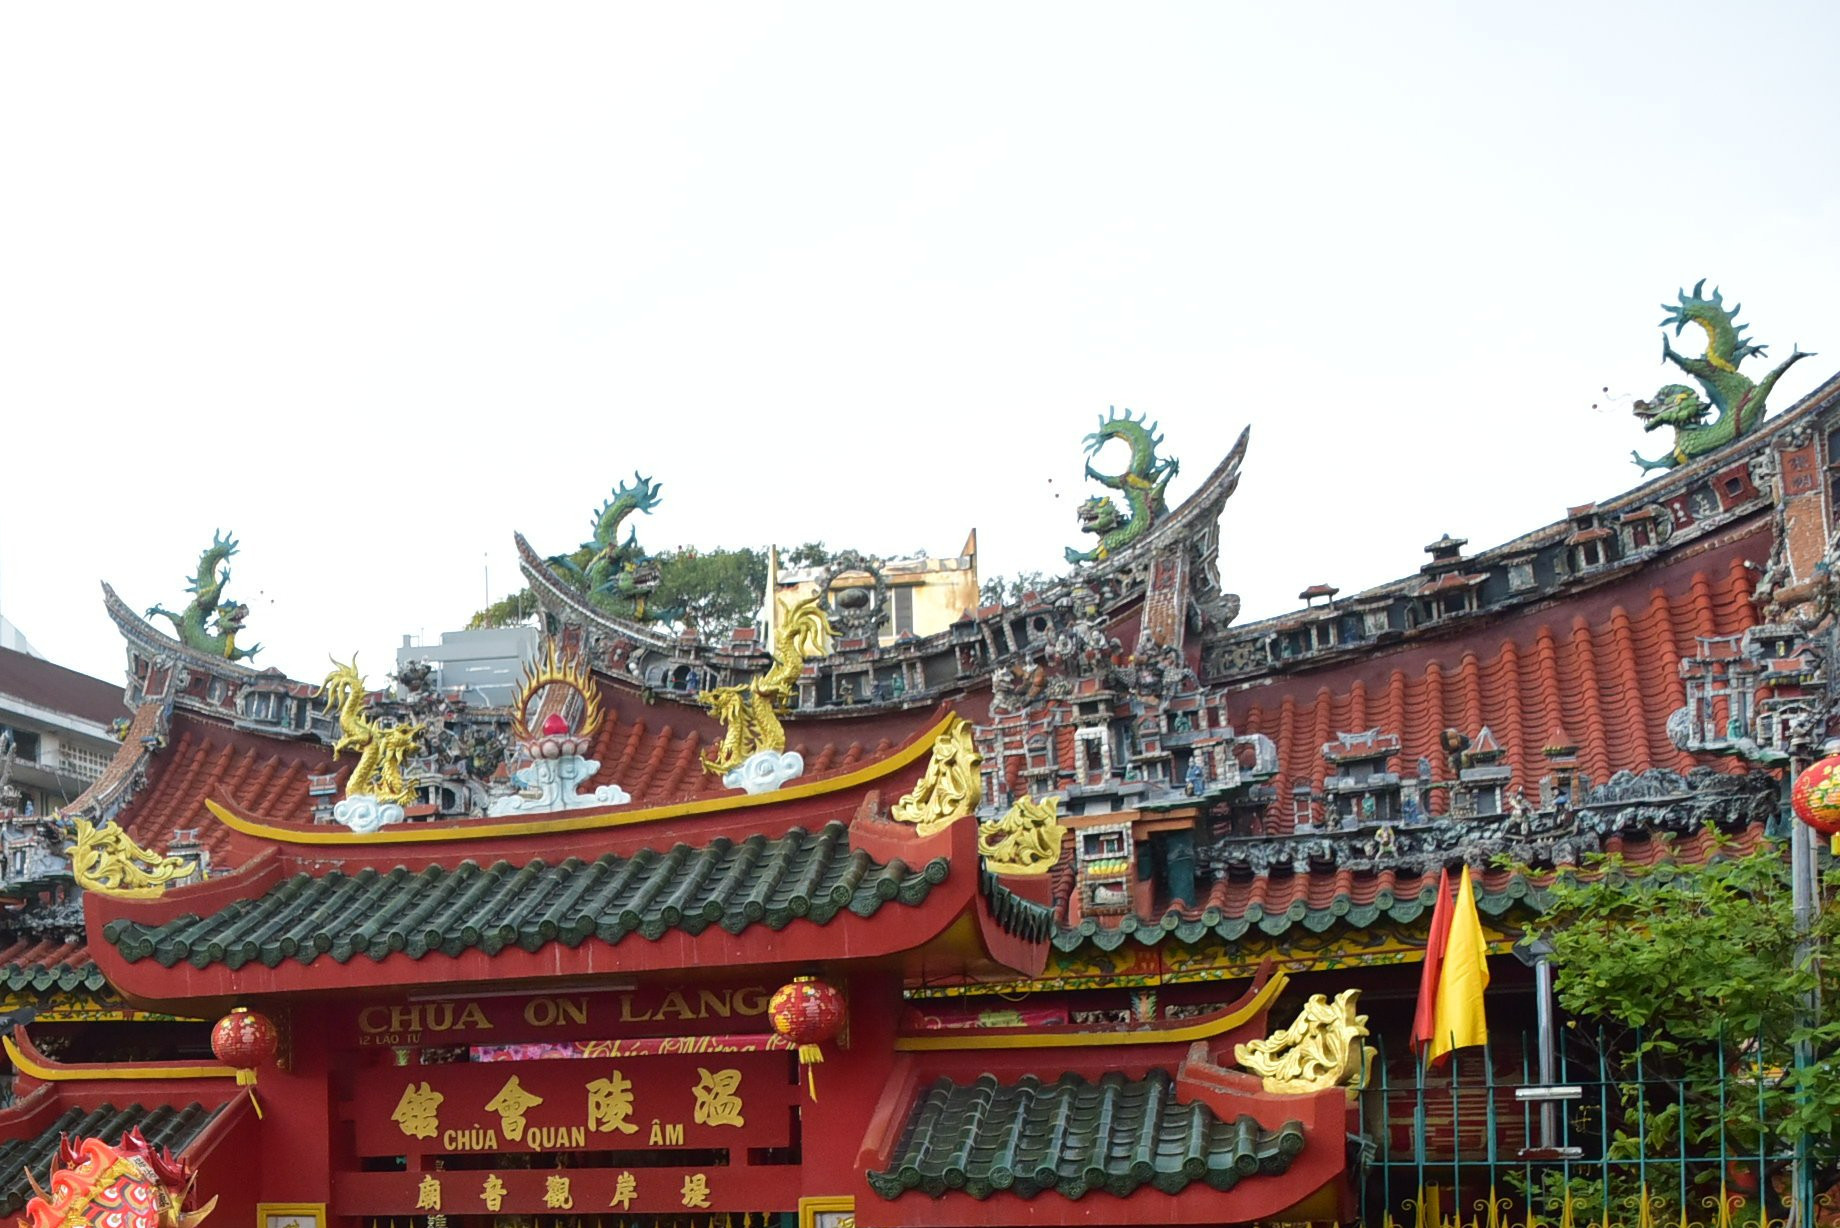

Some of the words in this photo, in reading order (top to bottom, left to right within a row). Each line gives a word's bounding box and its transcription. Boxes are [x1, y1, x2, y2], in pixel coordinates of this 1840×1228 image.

[443, 1123, 498, 1151] CHÙA
[526, 1126, 586, 1152] QUAN
[649, 1119, 684, 1146] ÂM
